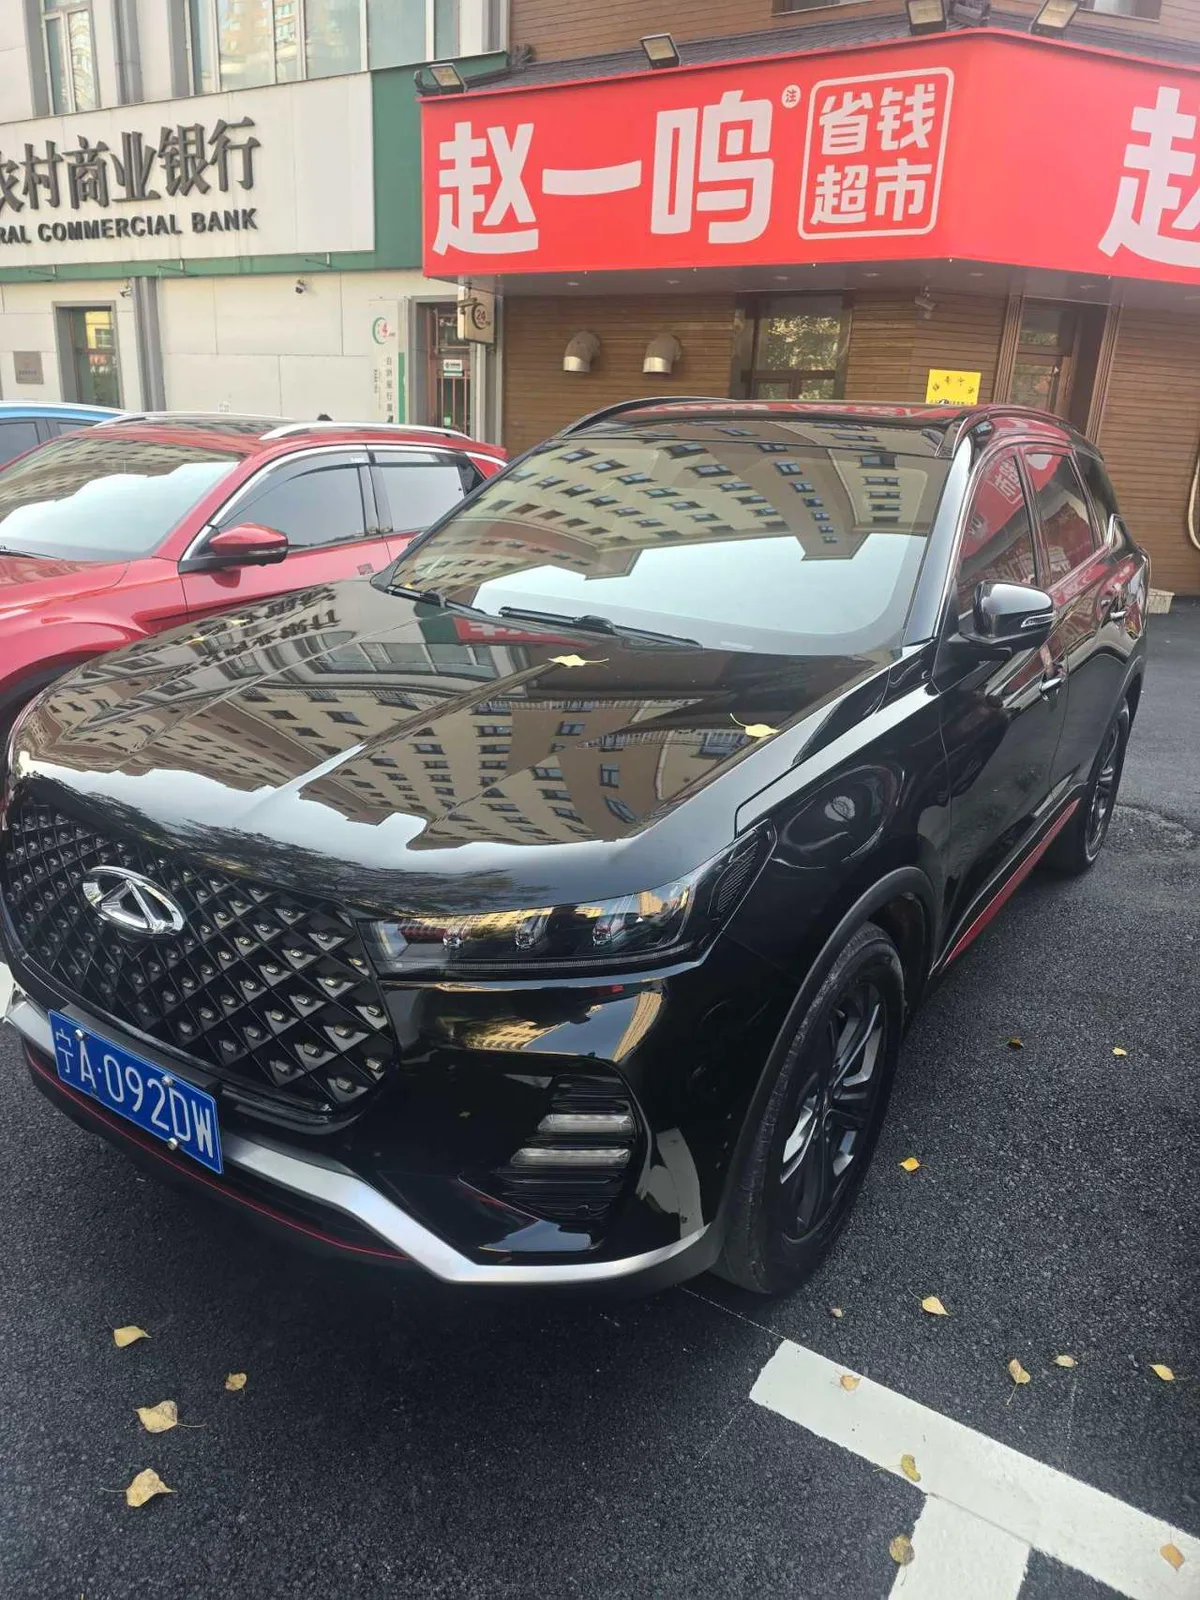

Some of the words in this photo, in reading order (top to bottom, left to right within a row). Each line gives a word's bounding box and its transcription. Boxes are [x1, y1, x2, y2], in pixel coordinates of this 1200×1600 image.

[819, 83, 936, 155] 省钱
[432, 90, 774, 256] 赵一鸣
[810, 158, 932, 225] 超市
[37, 214, 183, 242] COMMERCIAL
[191, 208, 258, 234] BANK
